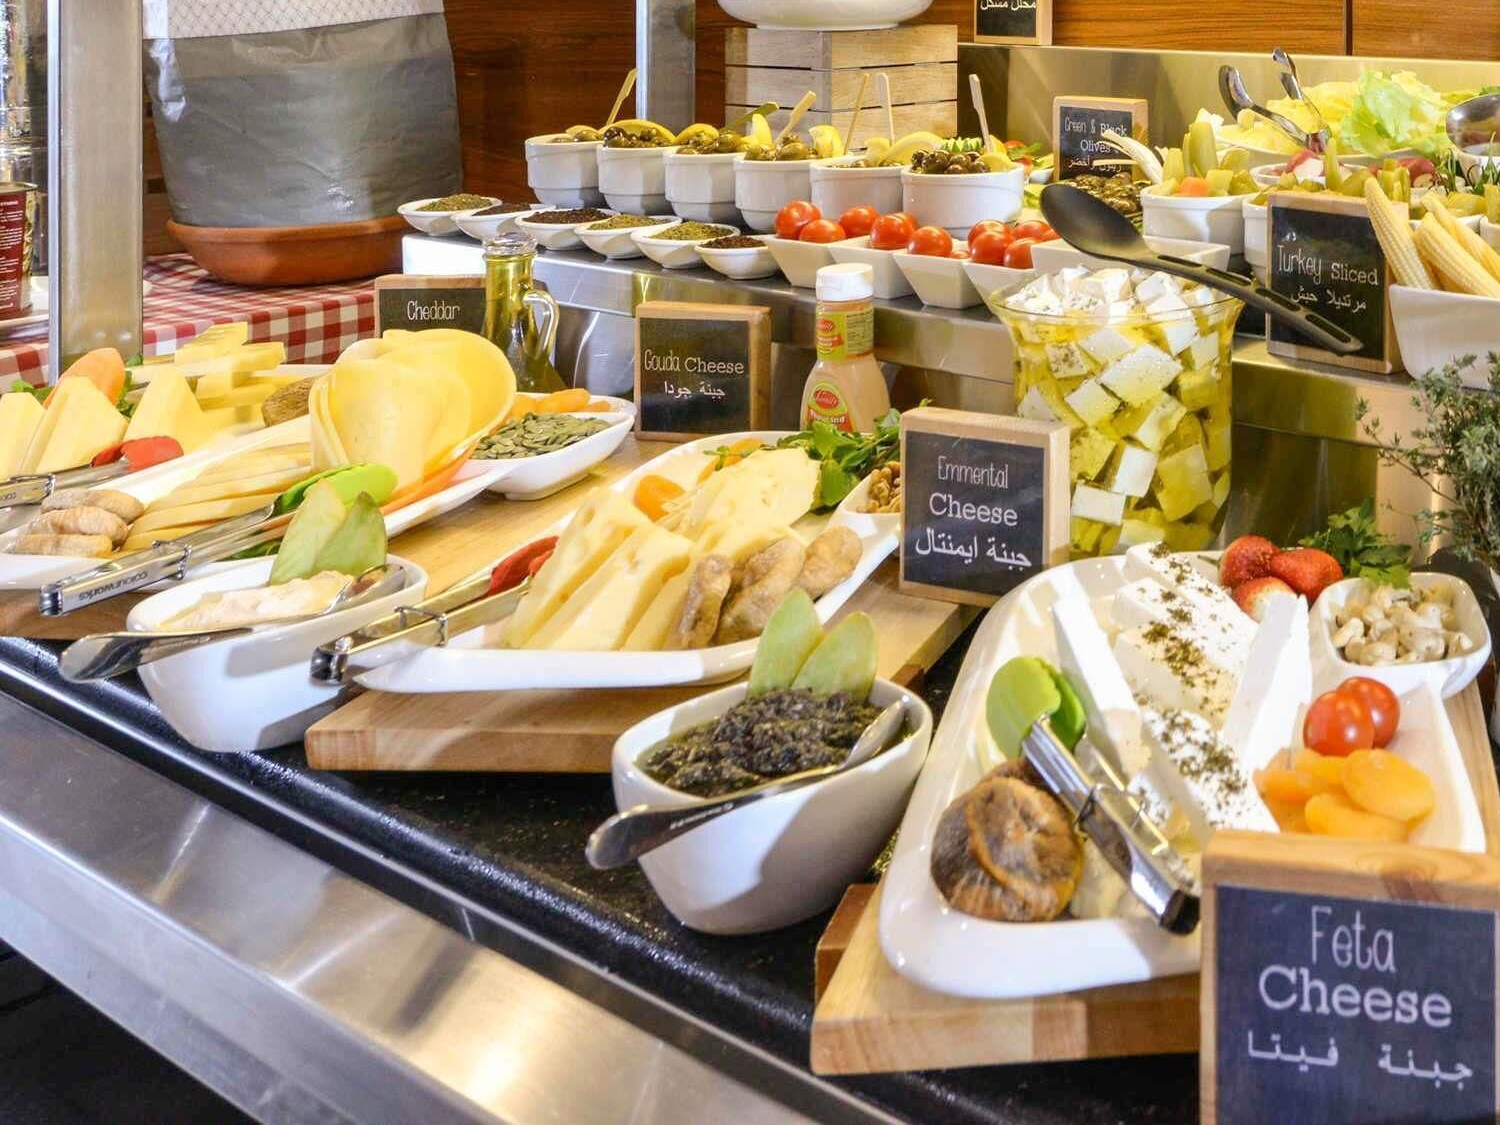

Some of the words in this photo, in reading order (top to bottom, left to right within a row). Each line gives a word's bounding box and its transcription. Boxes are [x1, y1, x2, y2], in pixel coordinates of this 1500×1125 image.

[1064, 116, 1087, 133] Green
[1080, 139, 1111, 153] Olives
[1277, 245, 1322, 285] Turkey
[1331, 261, 1379, 286] Sliced
[407, 300, 461, 321] Cheddar
[644, 348, 680, 372] Gouda
[685, 356, 744, 375] Cheese
[664, 381, 692, 400] جودا
[699, 381, 726, 400] جبنة
[938, 455, 1009, 489] Emmental
[929, 492, 1019, 526] Cheese
[915, 527, 978, 565] ايمنتال
[986, 536, 1032, 571] جبنة
[1311, 906, 1396, 973] Feta
[1259, 965, 1452, 1028] Cheese
[1248, 1031, 1339, 1072] فيتا
[1378, 1043, 1473, 1090] جبنة
